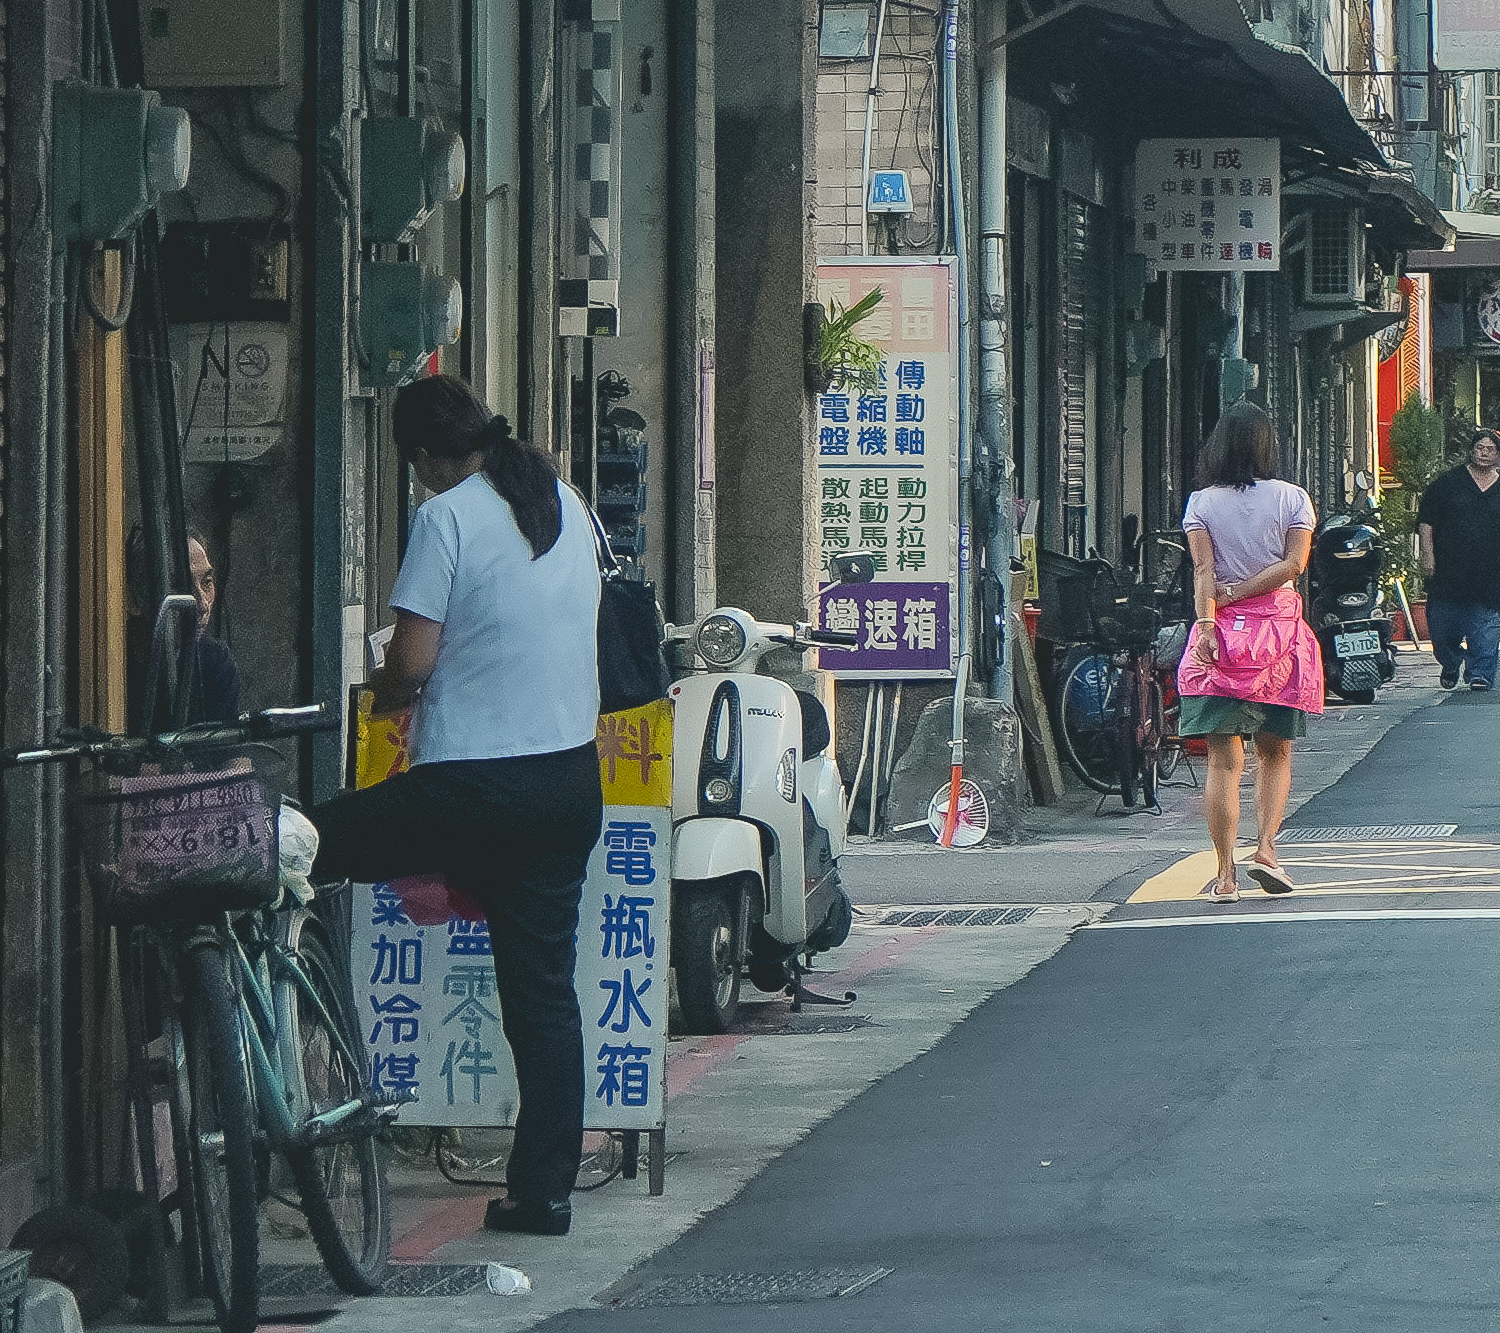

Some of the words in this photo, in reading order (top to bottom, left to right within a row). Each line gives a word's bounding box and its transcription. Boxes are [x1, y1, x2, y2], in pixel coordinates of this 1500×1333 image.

[1173, 148, 1243, 170] 利成
[819, 364, 850, 456] 電盤
[895, 360, 926, 456] 傳動軸
[825, 597, 937, 652] 變速箱
